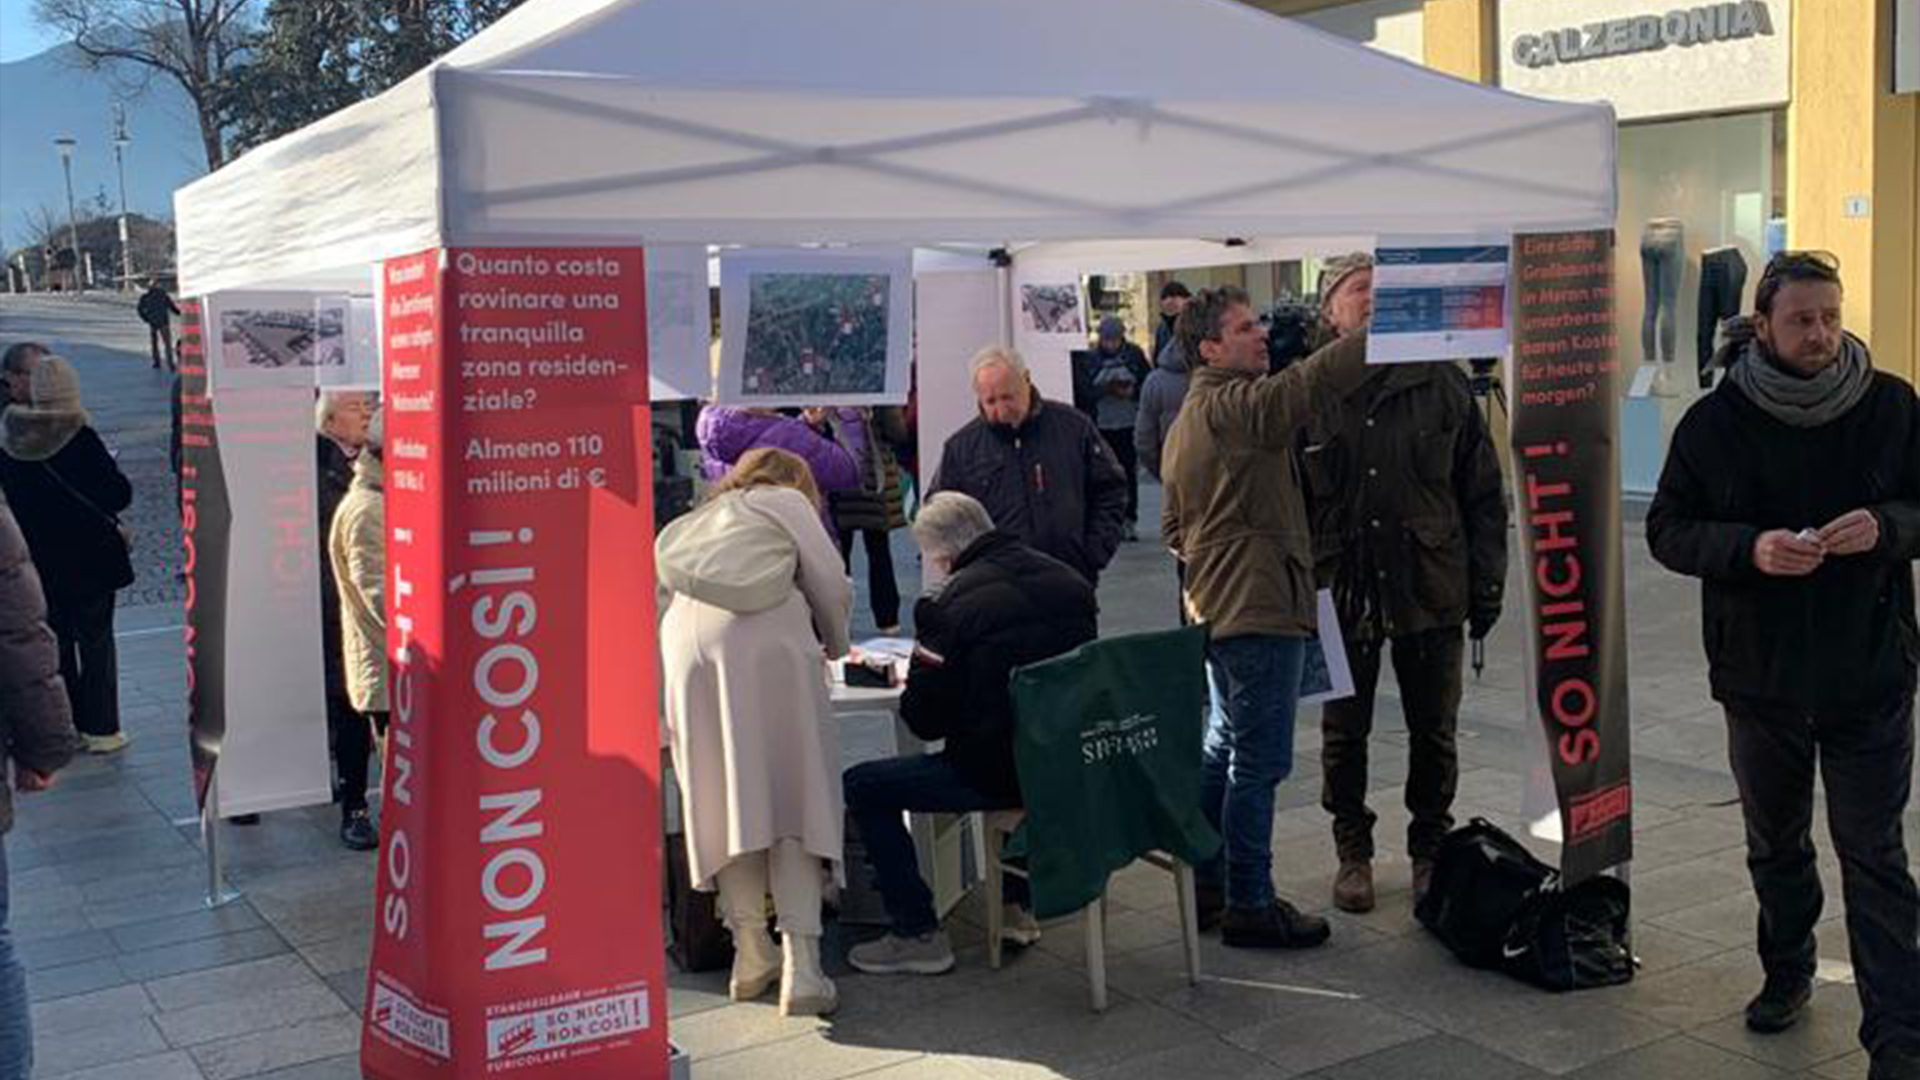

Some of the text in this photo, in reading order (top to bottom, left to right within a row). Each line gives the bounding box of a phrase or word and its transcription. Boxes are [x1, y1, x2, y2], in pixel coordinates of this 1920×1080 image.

[1512, 1, 1774, 68] CALZEDONIA
[457, 253, 620, 276] Quanto costa
[459, 288, 619, 309] rovinare una
[461, 321, 584, 347] tranquilla
[462, 355, 628, 377] zona residen-
[464, 389, 537, 410] ziale?
[465, 435, 602, 460] Almeno 110
[468, 467, 606, 493] milioni di €
[1552, 678, 1600, 767] SO
[385, 830, 408, 940] SO
[480, 789, 547, 971] NON
[547, 1012, 569, 1027] SO
[577, 1000, 626, 1021] NICHT
[547, 1027, 581, 1043] NON
